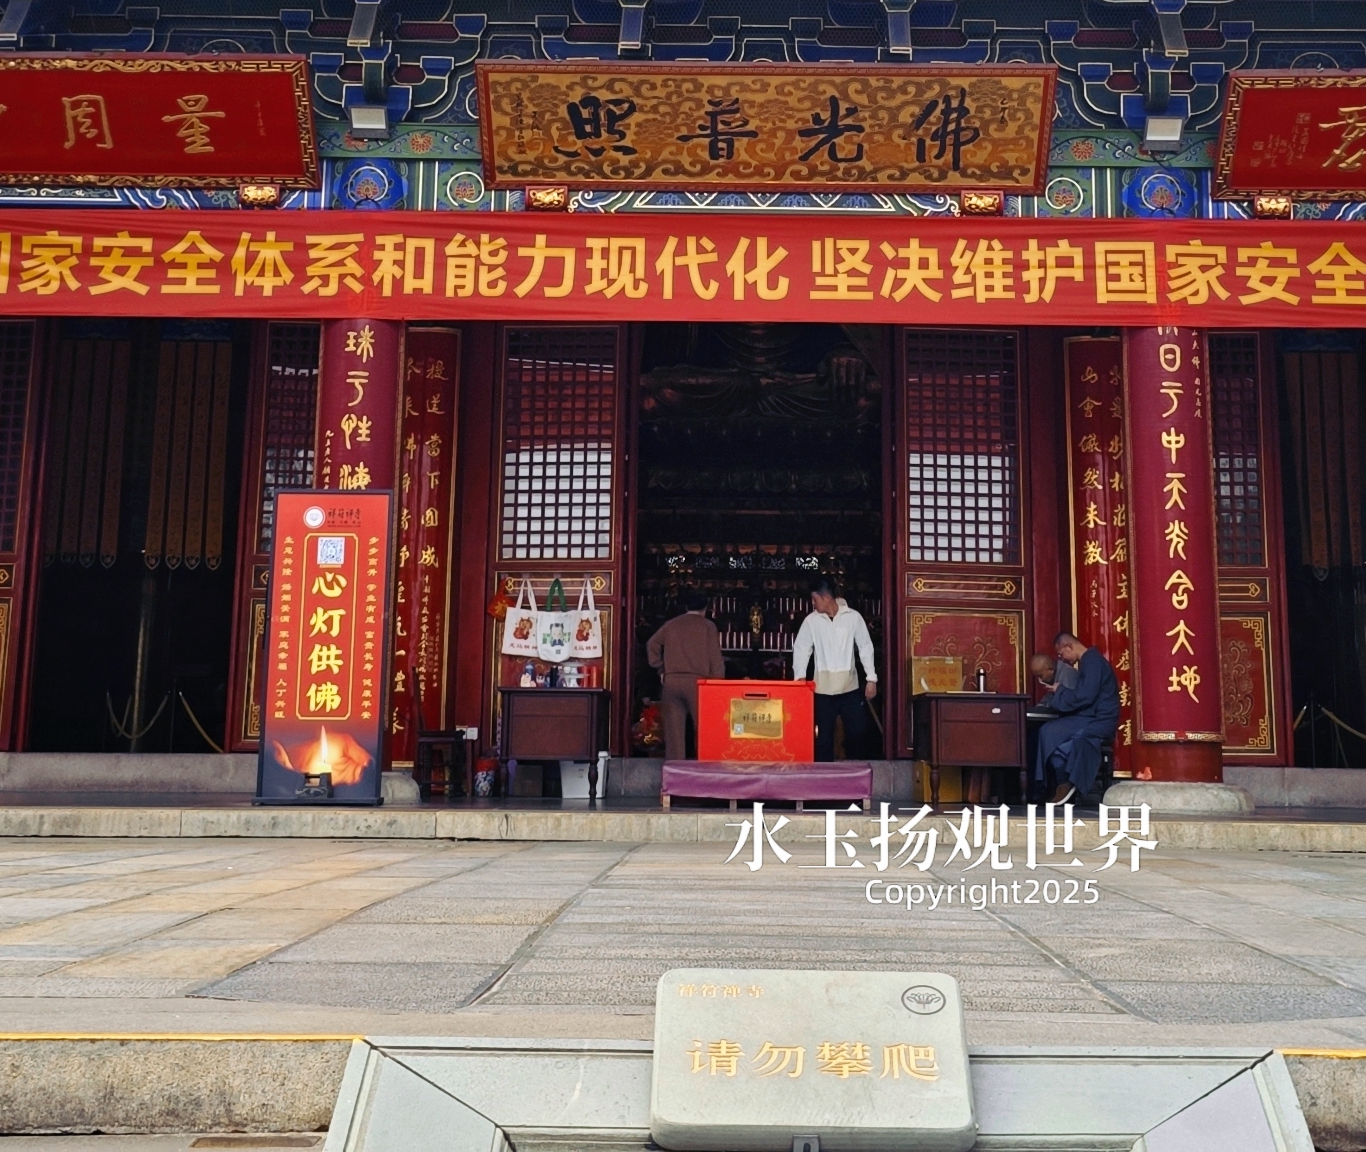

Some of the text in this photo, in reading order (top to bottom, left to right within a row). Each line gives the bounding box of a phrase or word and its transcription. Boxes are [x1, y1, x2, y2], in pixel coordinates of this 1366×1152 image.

[306, 569, 348, 714] 心灯供佛
[685, 1038, 942, 1081] 请勿攀爬
